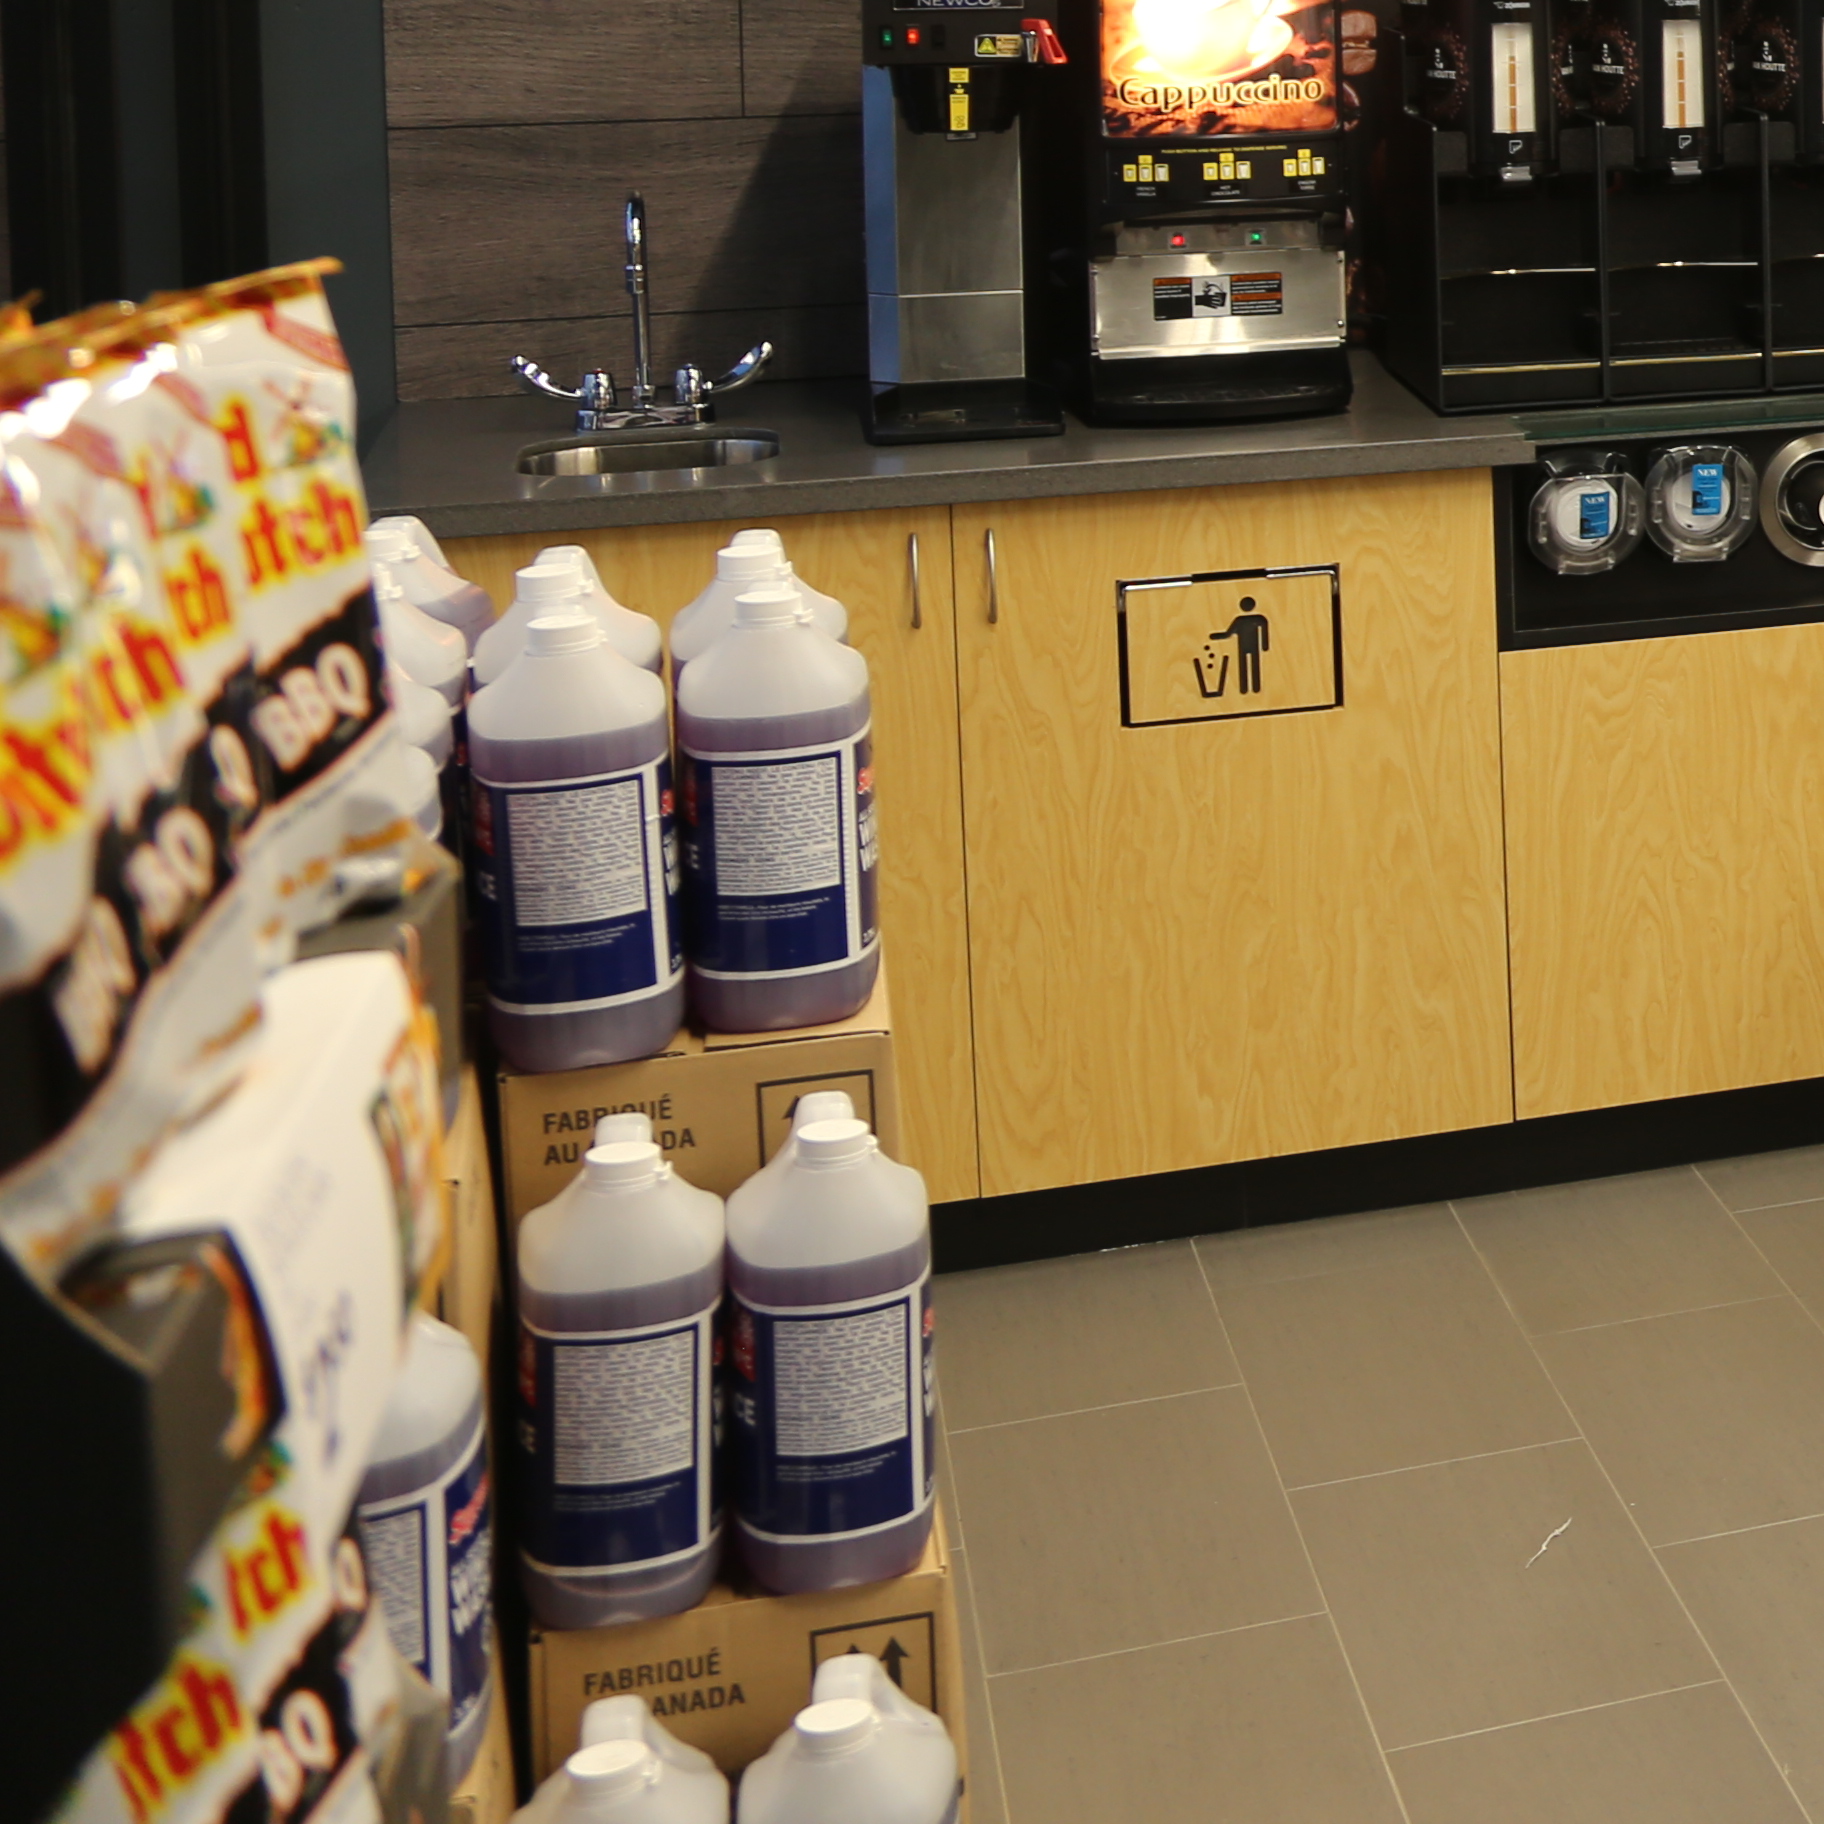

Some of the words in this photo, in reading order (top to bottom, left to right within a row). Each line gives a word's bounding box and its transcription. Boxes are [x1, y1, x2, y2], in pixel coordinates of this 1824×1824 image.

[1119, 73, 1322, 111] Cappuccino
[253, 642, 370, 771] BBQ
[582, 1646, 723, 1696] FABRIQUÉ
